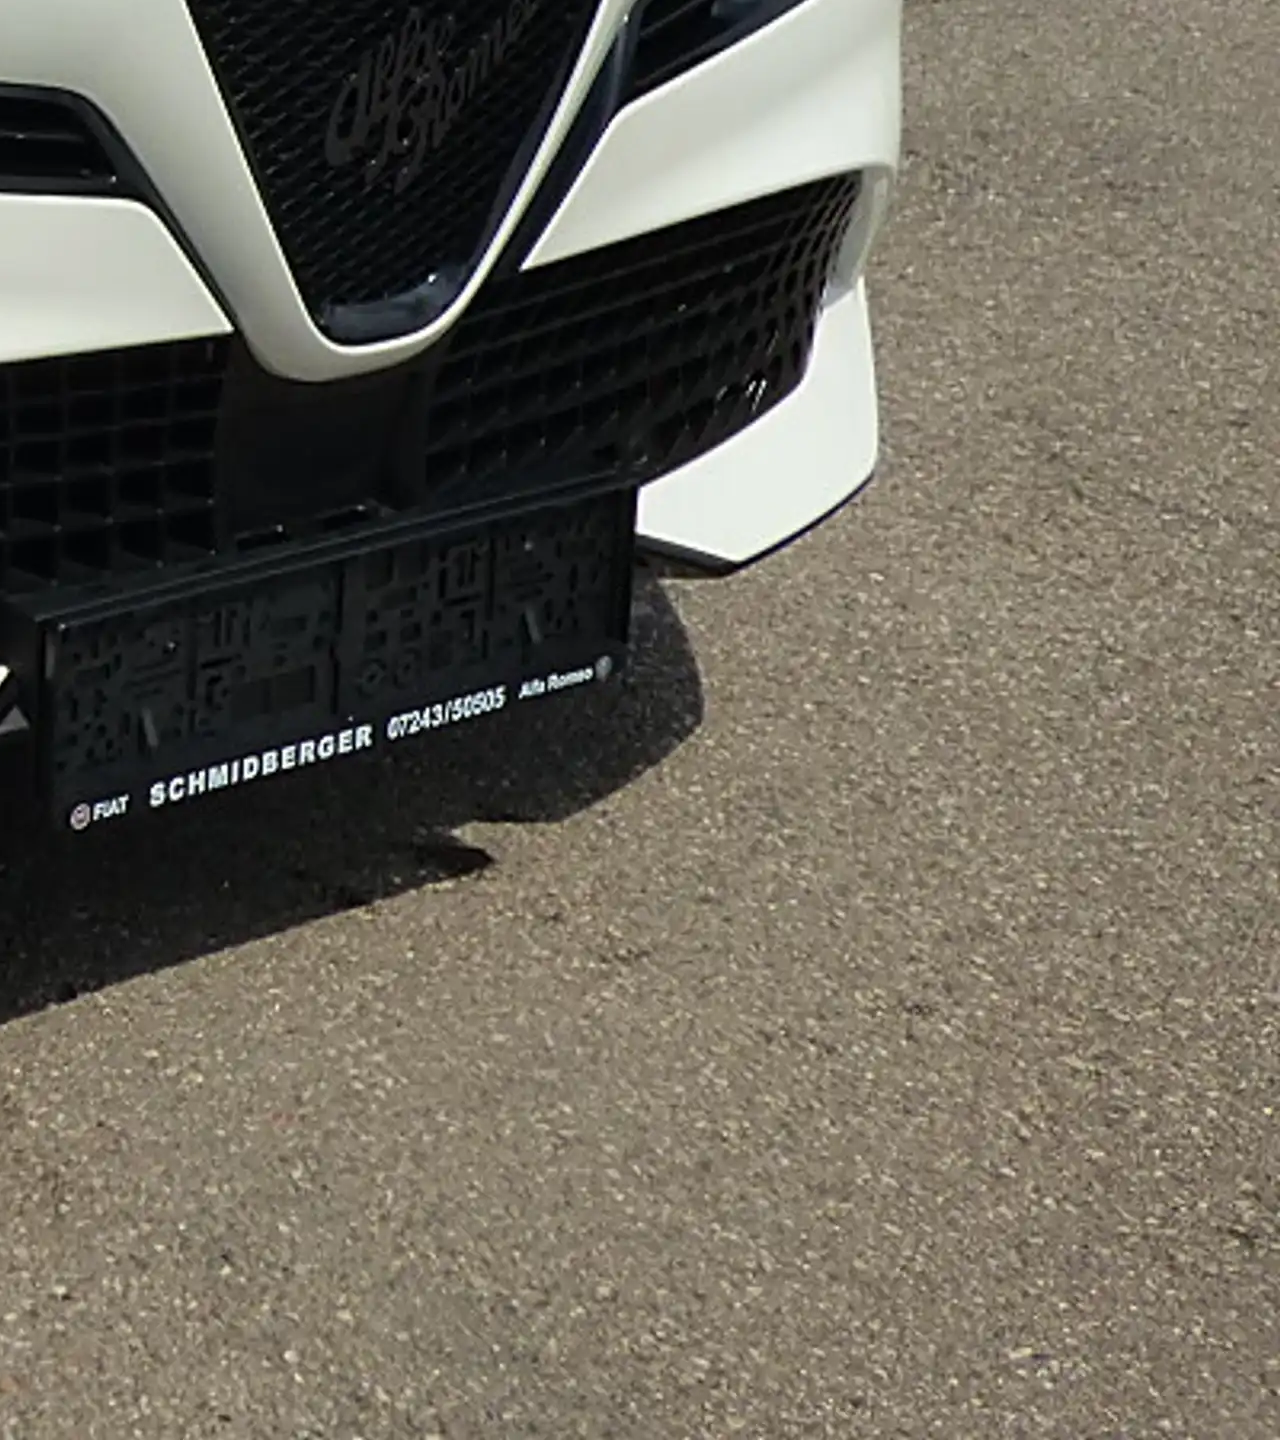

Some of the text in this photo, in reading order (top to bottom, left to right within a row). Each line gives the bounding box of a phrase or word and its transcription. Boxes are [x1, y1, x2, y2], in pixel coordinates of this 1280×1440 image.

[92, 793, 130, 821] FIAT
[149, 723, 373, 808] SCHMIDBERGER
[517, 677, 546, 700] Alfa
[546, 666, 594, 692] Romeo
